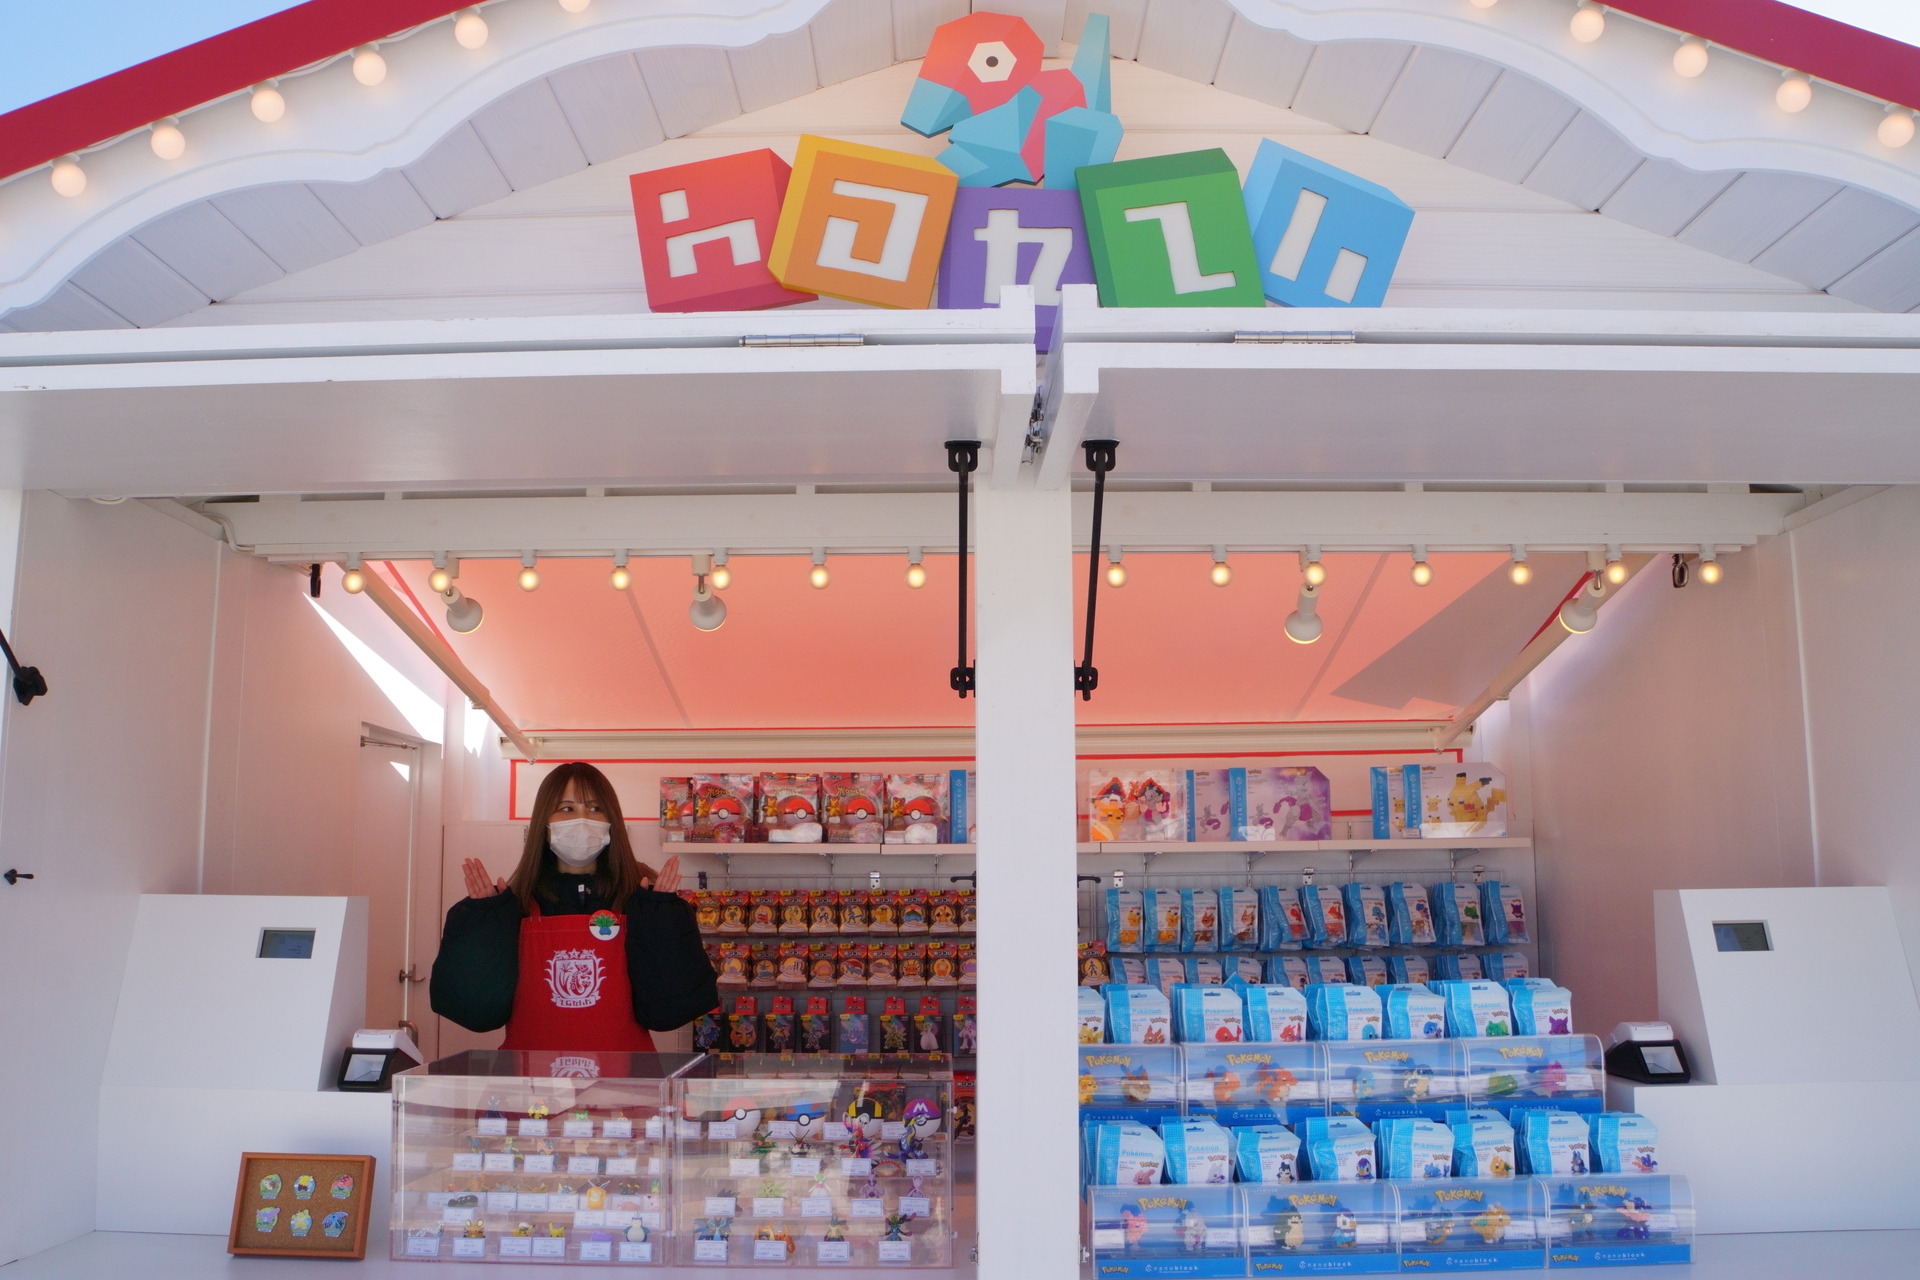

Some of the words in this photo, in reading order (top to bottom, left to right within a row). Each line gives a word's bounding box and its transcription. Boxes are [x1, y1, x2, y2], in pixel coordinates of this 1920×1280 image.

[913, 1102, 929, 1113] M
[1187, 1144, 1219, 1152] Pokémon
[1413, 1142, 1444, 1150] Pokémon
[1121, 1149, 1154, 1157] Pokémon
